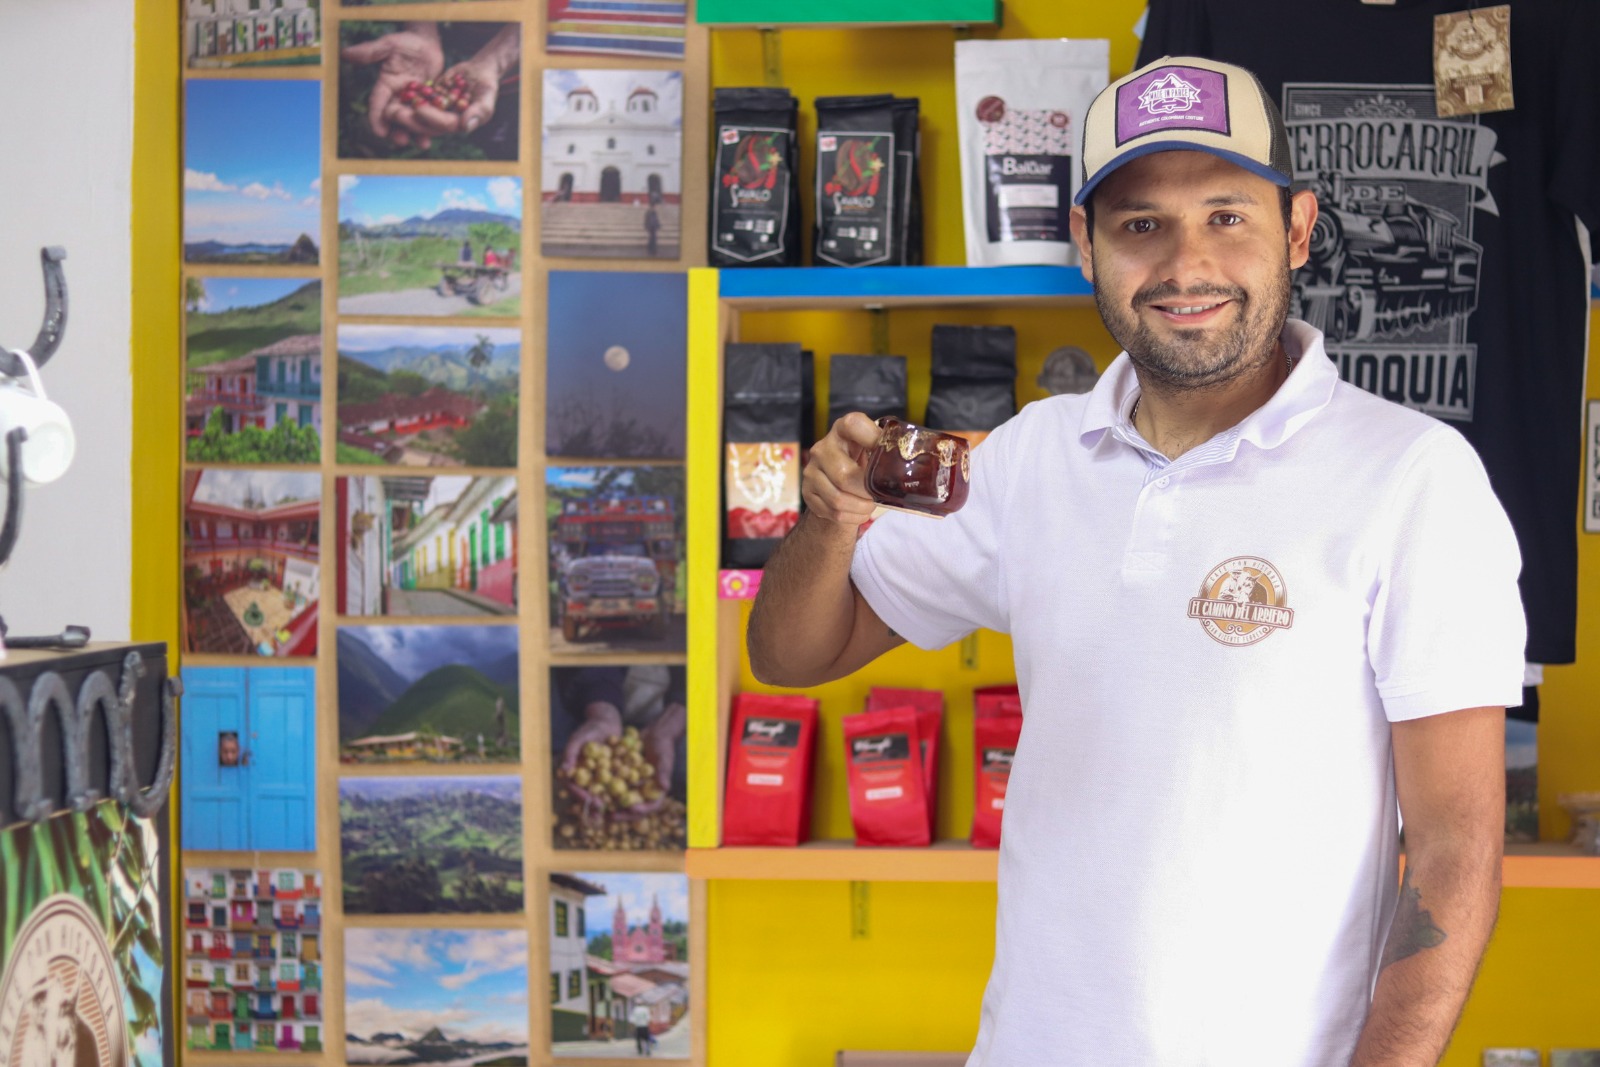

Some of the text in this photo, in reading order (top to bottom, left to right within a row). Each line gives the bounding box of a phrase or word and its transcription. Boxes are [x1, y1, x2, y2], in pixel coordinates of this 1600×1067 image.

[1293, 103, 1322, 117] SINCE
[1287, 121, 1483, 178] ERROCARRIL
[1350, 184, 1405, 201] DE
[1252, 561, 1280, 589] HISTORIA
[1191, 600, 1291, 627] EL CAMINO DEL ARRIERO
[1218, 632, 1240, 643] VICENTE
[61, 922, 114, 1022] HISTORIA
